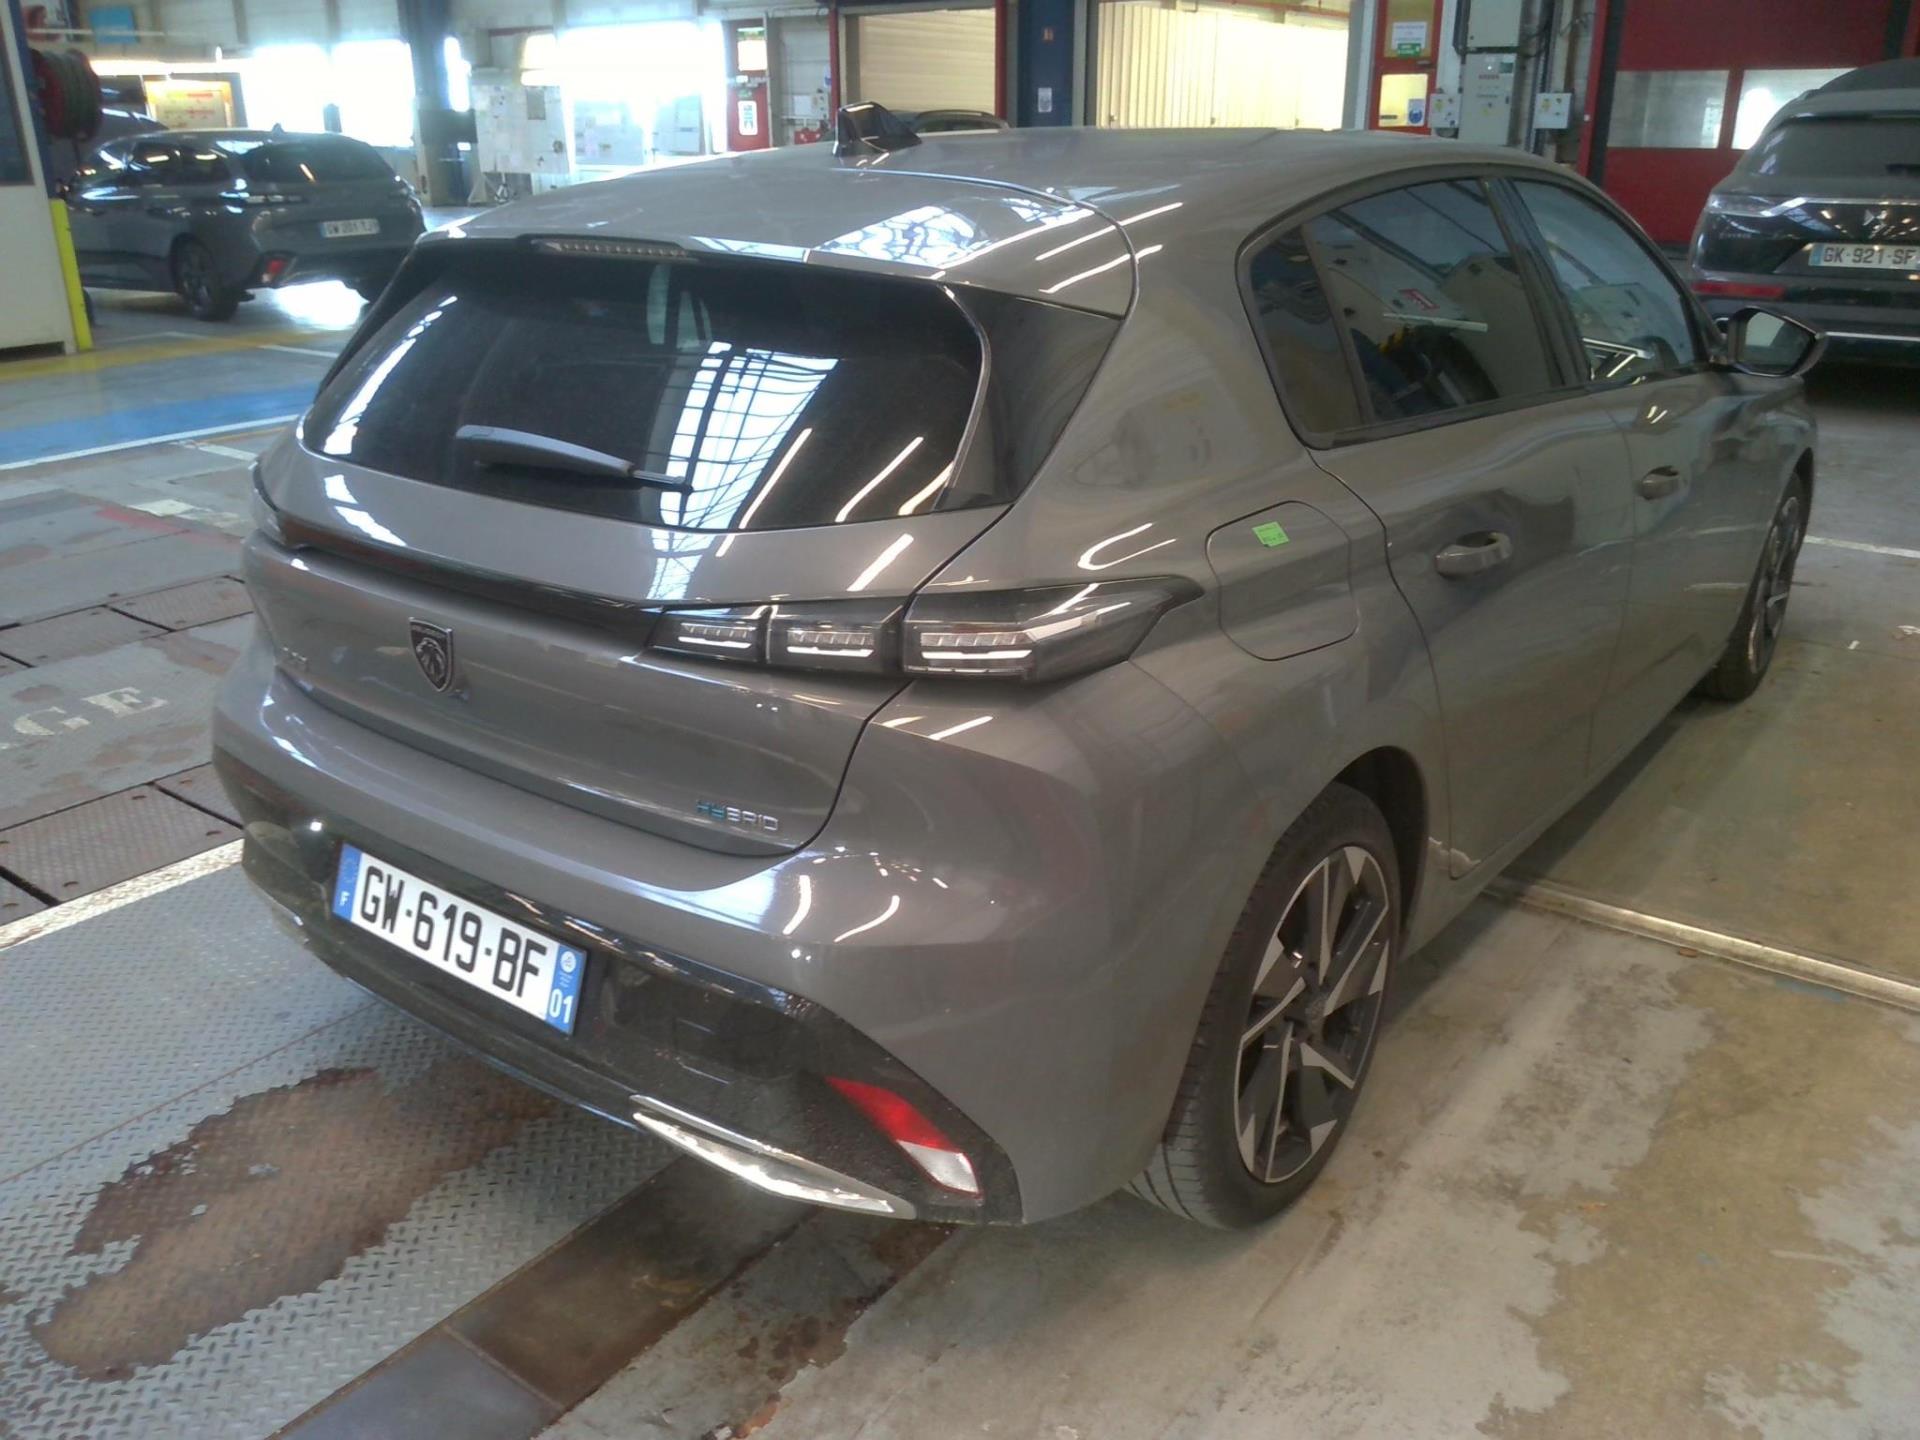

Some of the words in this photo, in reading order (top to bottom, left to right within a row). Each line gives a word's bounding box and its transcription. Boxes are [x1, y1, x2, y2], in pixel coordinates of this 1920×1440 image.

[0, 687, 168, 750] GE
[340, 891, 350, 907] F
[360, 865, 548, 998] GW-619-BF
[549, 988, 574, 1024] 01
